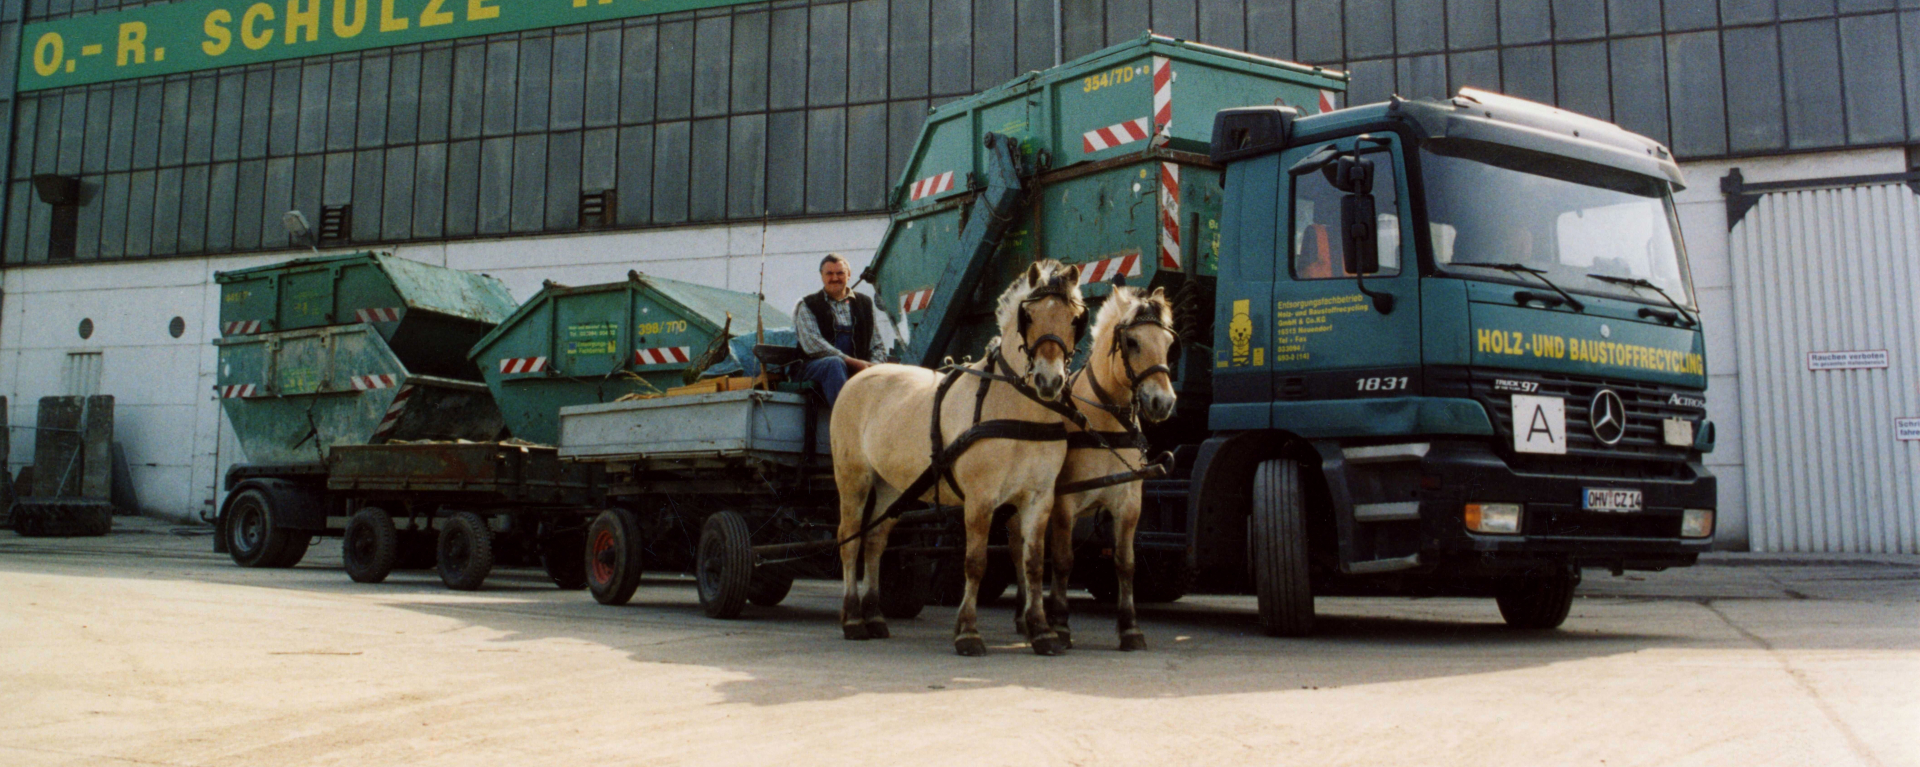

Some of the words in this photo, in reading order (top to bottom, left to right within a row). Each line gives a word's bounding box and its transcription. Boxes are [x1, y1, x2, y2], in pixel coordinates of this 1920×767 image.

[33, 21, 165, 77] O.-R.
[1083, 66, 1134, 93] 354/7D
[1277, 294, 1363, 310] Entsorgungsfachbetrieb
[1295, 309, 1307, 317] und
[1308, 304, 1369, 316] Baustoffrecycling
[1277, 319, 1297, 327] GmbH
[1298, 324, 1333, 334] Neuendorf
[1569, 337, 1703, 376] BAUSTOFFRECYCLING
[1811, 353, 1847, 361] Rauchen
[1355, 376, 1409, 391] 1831
[1526, 403, 1555, 444] A
[1588, 491, 1608, 507] OHV
[1614, 492, 1627, 508] CZ
[1628, 492, 1642, 508] 14
